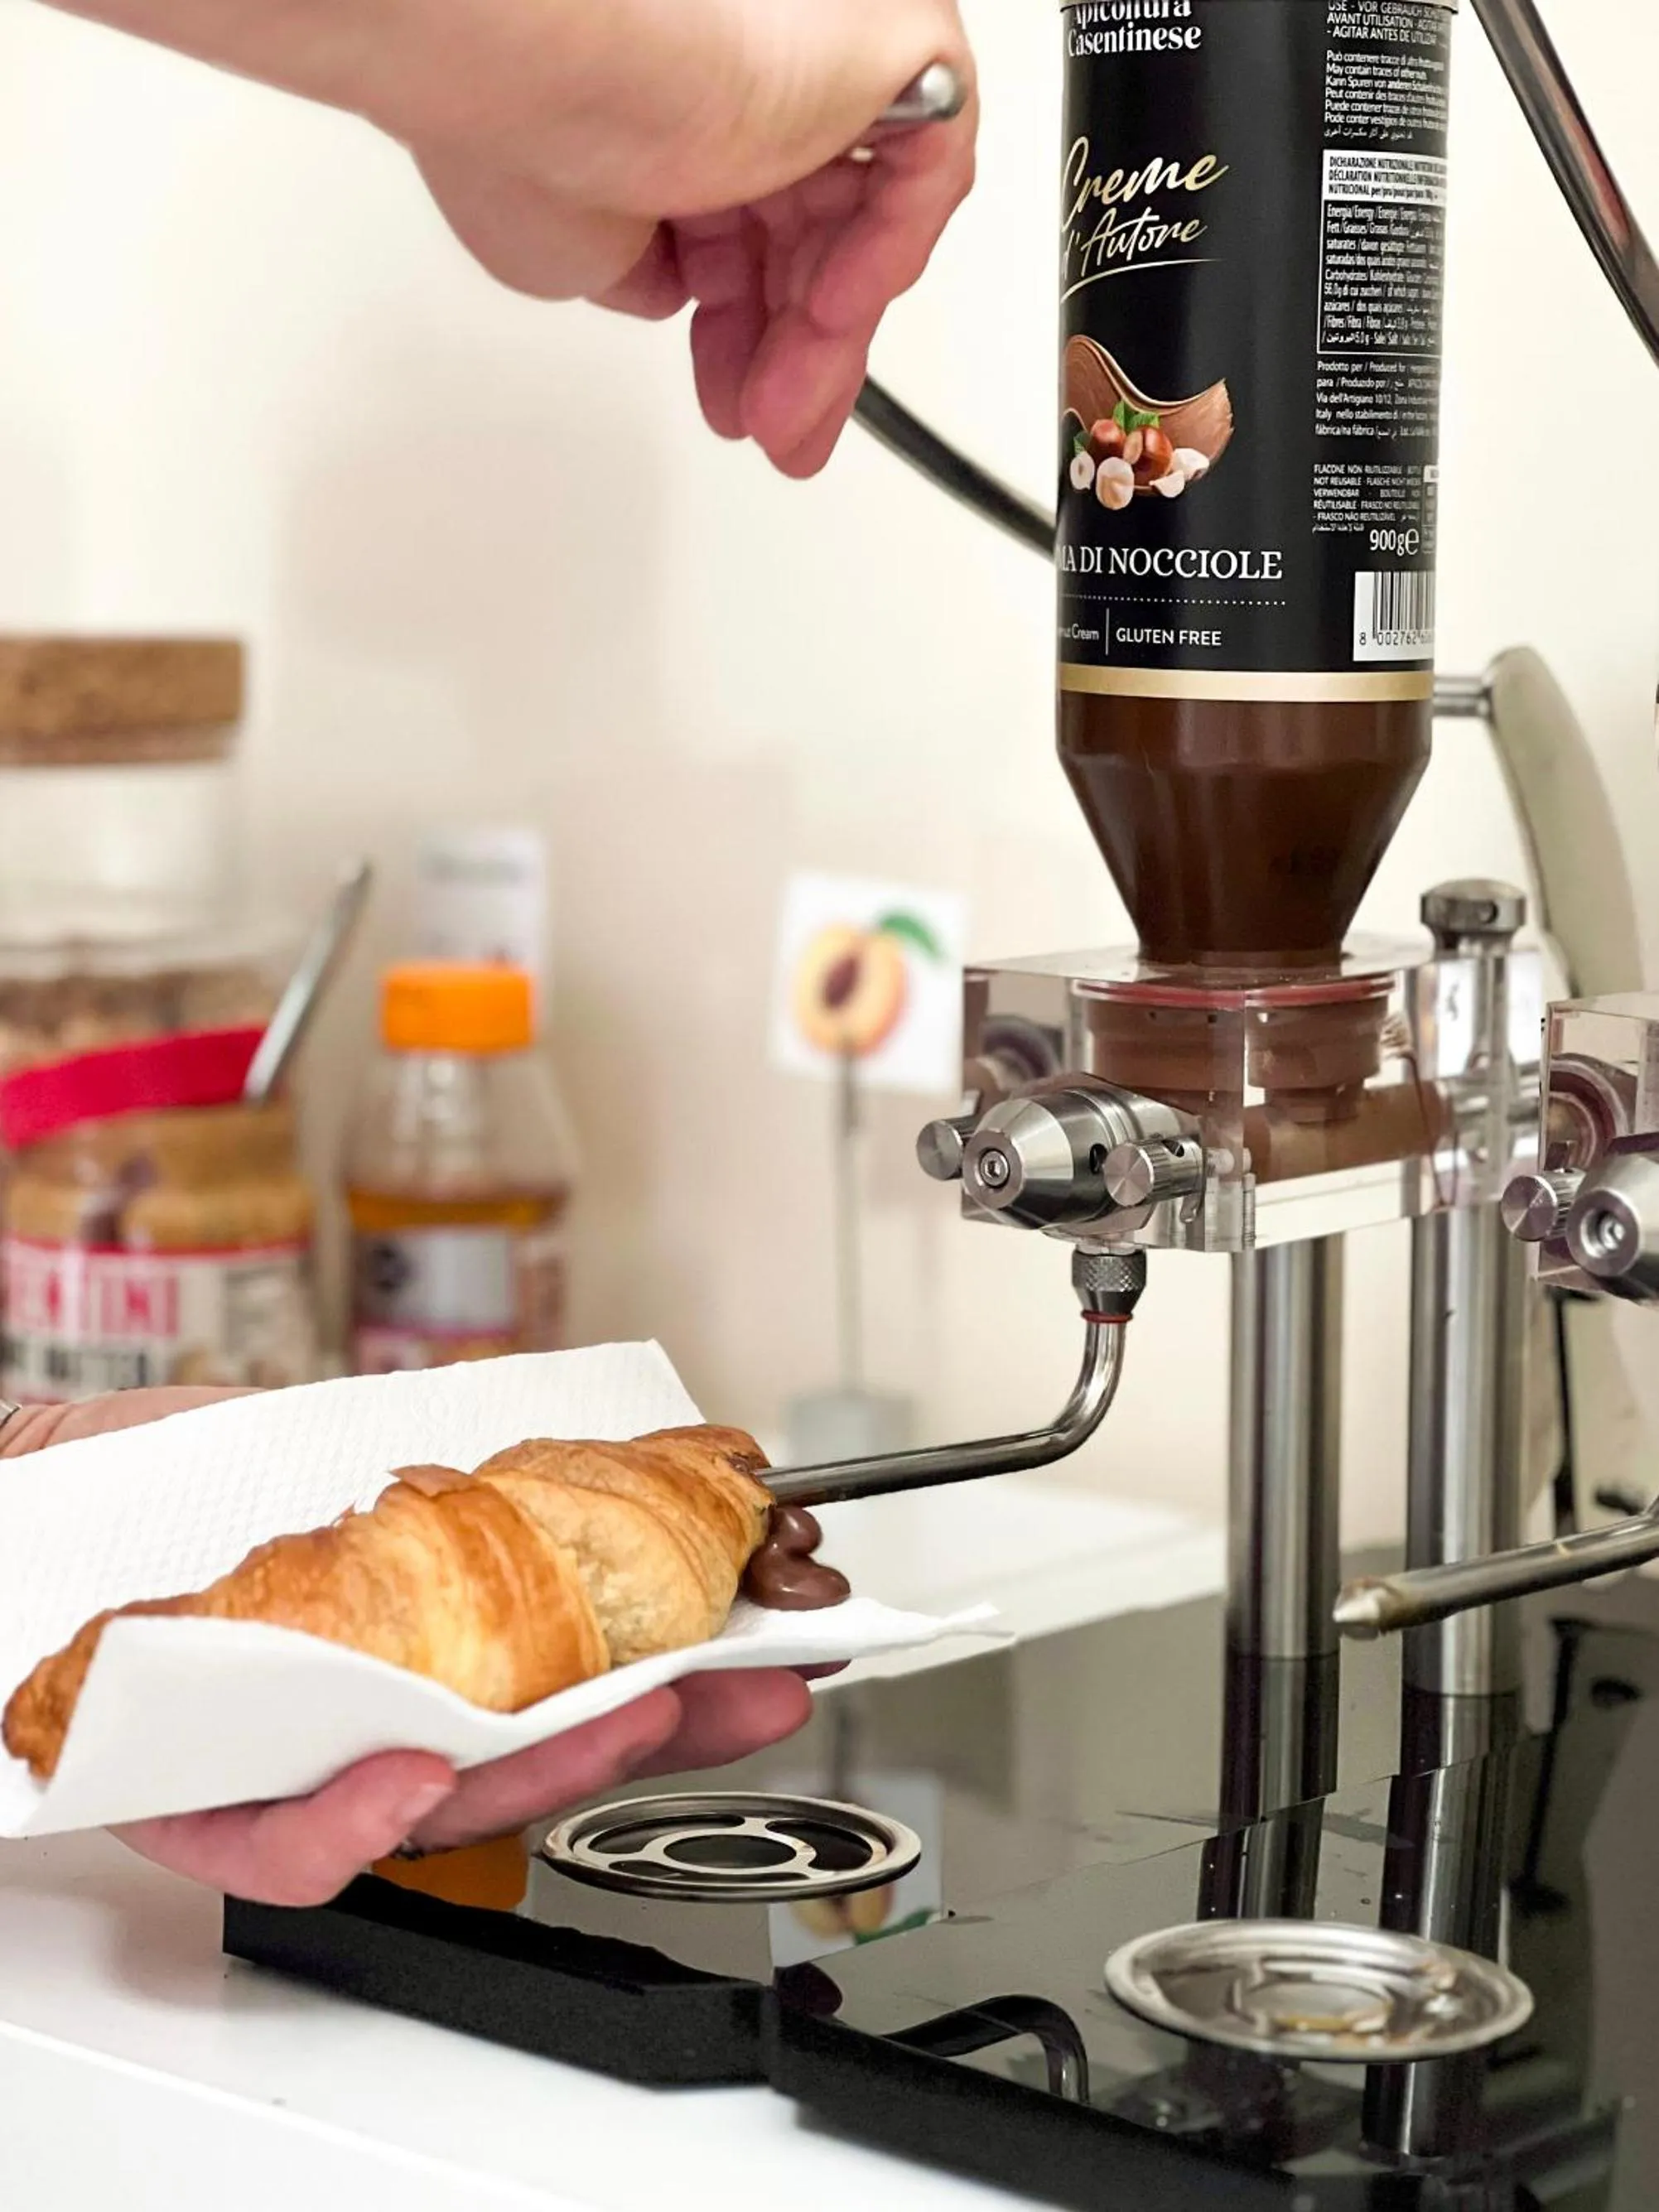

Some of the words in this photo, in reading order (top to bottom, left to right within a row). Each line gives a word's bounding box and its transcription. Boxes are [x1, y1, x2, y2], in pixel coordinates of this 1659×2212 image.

[1358, 2, 1377, 12] VOR
[1327, 12, 1362, 24] AVANT
[1363, 15, 1413, 28] UTILISATION
[1068, 22, 1202, 56] Casentinese
[1333, 26, 1368, 39] AGITAR
[1370, 28, 1398, 41] ANTES
[1400, 31, 1410, 42] DE
[1327, 50, 1342, 61] Può
[1326, 63, 1343, 75] May
[1345, 64, 1372, 75] contain
[1373, 67, 1392, 76] traces
[1325, 75, 1347, 86] Kann
[1348, 76, 1373, 88] Spuren
[1325, 88, 1343, 99] Peut
[1345, 89, 1375, 100] contenir
[1325, 99, 1349, 111] Puede
[1351, 102, 1383, 113] contener
[1324, 112, 1345, 123] Pode
[1346, 114, 1369, 124] conter
[1061, 136, 1229, 233] Creme
[1317, 360, 1349, 372] Prodotto
[1351, 364, 1362, 374] per
[1317, 378, 1334, 390] para
[1317, 393, 1327, 403] Via
[1315, 409, 1332, 421] Italy
[1314, 464, 1345, 474] FLACONE
[1348, 465, 1362, 474] NON
[1314, 476, 1329, 485] NOT
[1330, 477, 1362, 485] REUSABLE
[1314, 489, 1360, 497] VERWENDBAR
[1314, 499, 1357, 509] RÉUTILISABLE
[1345, 512, 1358, 520] NÃO
[1080, 547, 1103, 574] DI
[1110, 547, 1282, 580] NOCCIOLE
[1072, 623, 1099, 640] Cream
[1116, 628, 1174, 644] GLUTEN
[1179, 629, 1222, 646] FREE
[1359, 632, 1367, 646] 8
